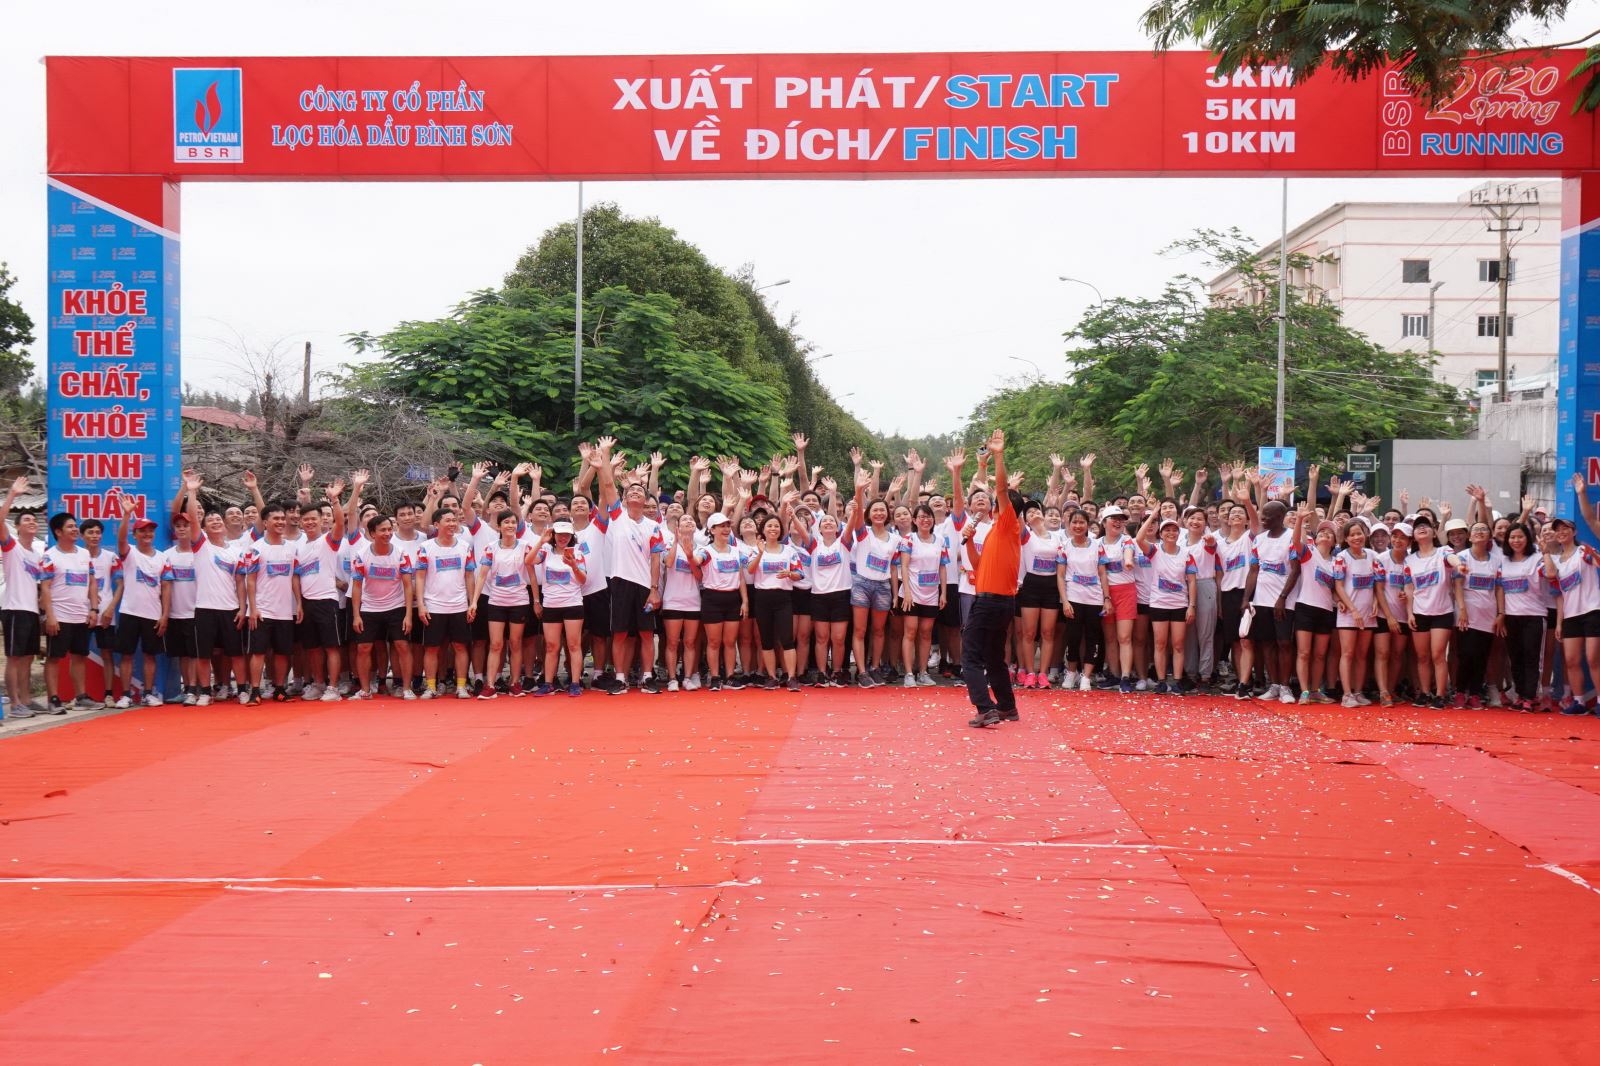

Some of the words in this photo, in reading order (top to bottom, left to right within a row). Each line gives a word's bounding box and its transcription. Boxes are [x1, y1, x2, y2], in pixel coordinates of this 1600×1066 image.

[612, 66, 753, 110] XUẤT
[1205, 65, 1296, 88] 3KM
[300, 85, 357, 112] CÔNG
[361, 90, 388, 112] TY
[393, 80, 422, 112] CỔ
[426, 79, 485, 112] PHẦN
[1205, 98, 1296, 121] 5KM
[1382, 70, 1413, 156] BSR
[1425, 66, 1560, 125] 2020
[1463, 95, 1561, 126] Spring
[179, 132, 239, 143] PETROVIETNAM
[271, 124, 313, 151] LỌC
[317, 119, 362, 147] HÓA
[366, 114, 411, 147] DẦU
[415, 119, 467, 147] BÌNH
[471, 121, 514, 147] SƠN
[654, 115, 721, 161] VỀ
[1182, 131, 1296, 153] 10KM
[1420, 132, 1564, 156] RUNNING
[188, 147, 229, 158] BSR
[62, 281, 148, 316] KHỎE
[73, 320, 137, 357] THỂ
[59, 363, 151, 401] CHẤT,
[62, 404, 148, 439] KHỎE
[66, 452, 143, 480] TINH
[61, 485, 147, 520] THẦN
